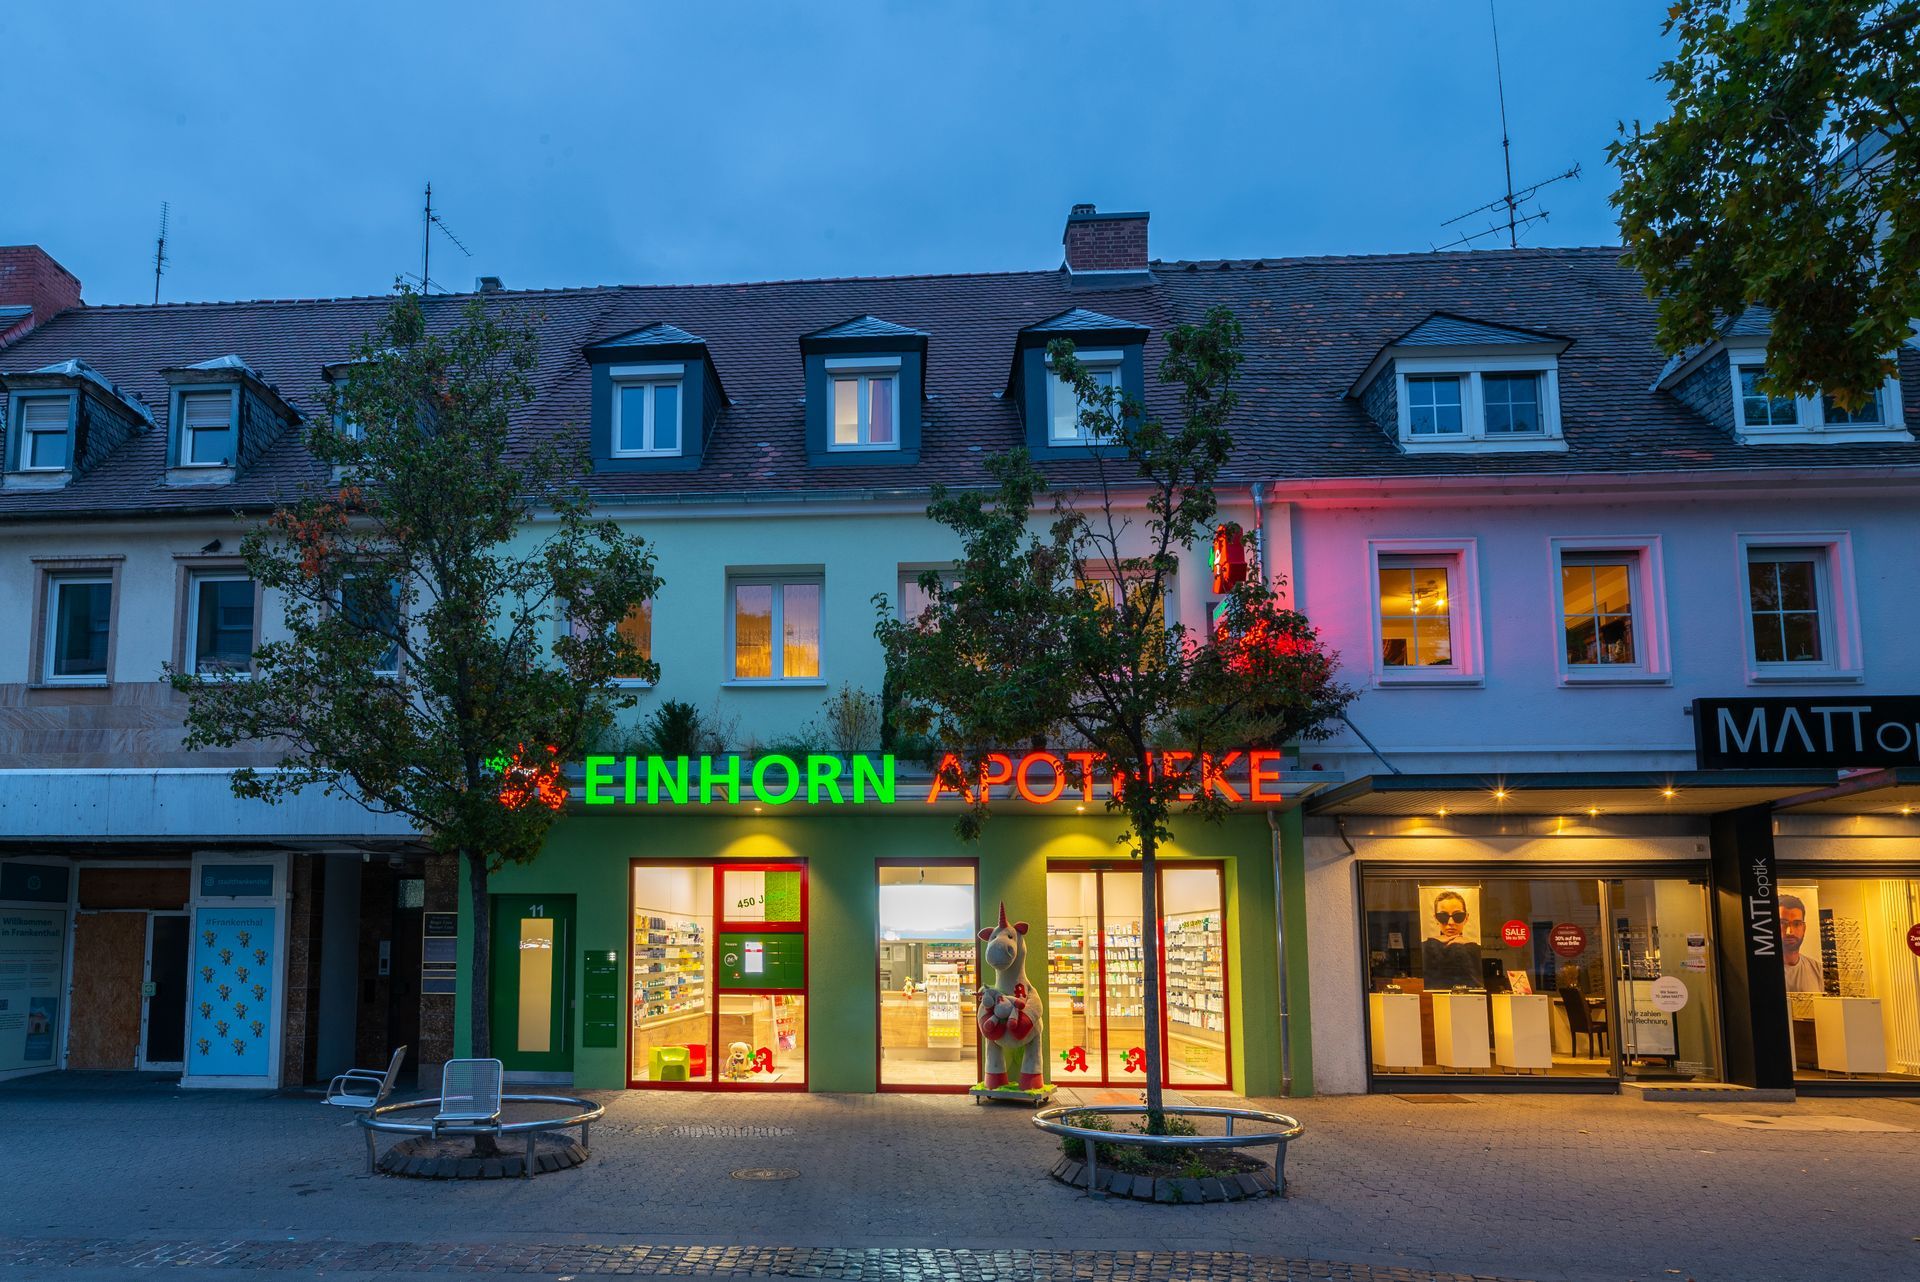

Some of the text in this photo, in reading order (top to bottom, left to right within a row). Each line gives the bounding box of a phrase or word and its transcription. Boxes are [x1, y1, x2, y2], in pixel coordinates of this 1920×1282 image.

[1717, 705, 1872, 753] MATT
[585, 754, 896, 805] EINHORN
[737, 897, 756, 909] 450
[529, 904, 544, 918] 11
[1505, 928, 1526, 936] SALE
